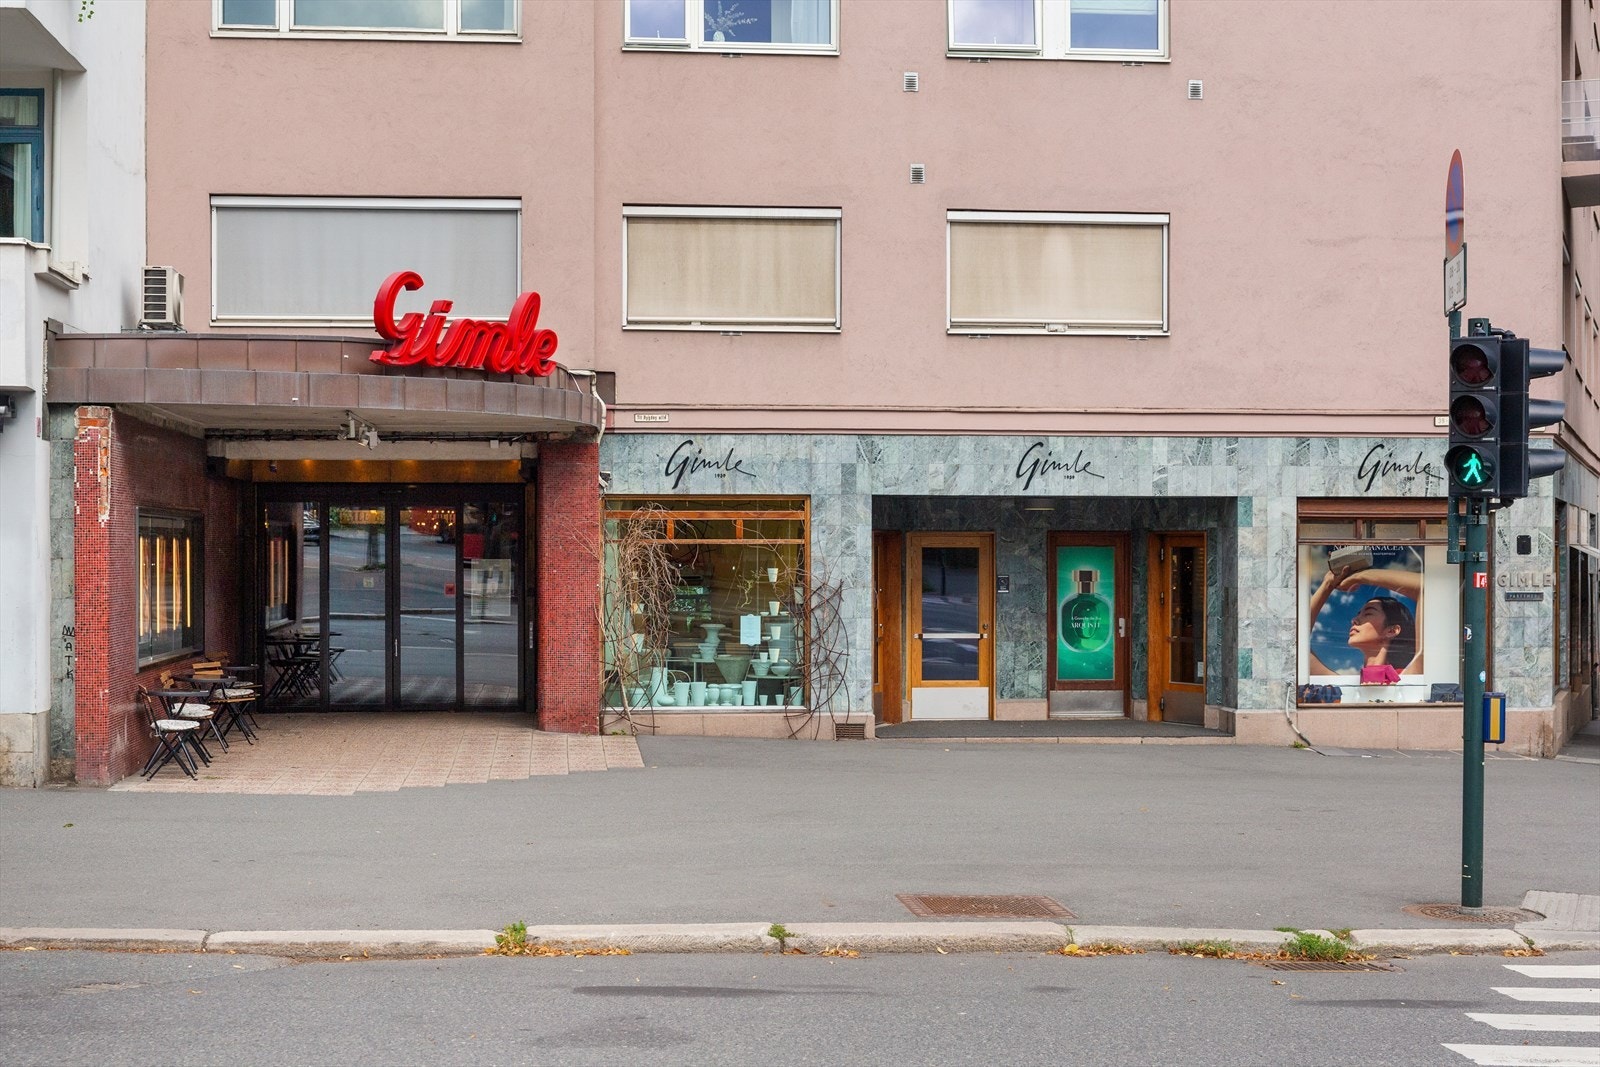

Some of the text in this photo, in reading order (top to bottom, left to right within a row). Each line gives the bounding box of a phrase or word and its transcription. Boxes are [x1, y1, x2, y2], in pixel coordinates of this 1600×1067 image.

[369, 271, 558, 377] Gimle
[665, 440, 756, 490] Gimle
[1016, 442, 1105, 491] Gimle
[1358, 444, 1444, 493] Gimle
[1497, 572, 1553, 588] GIMLE
